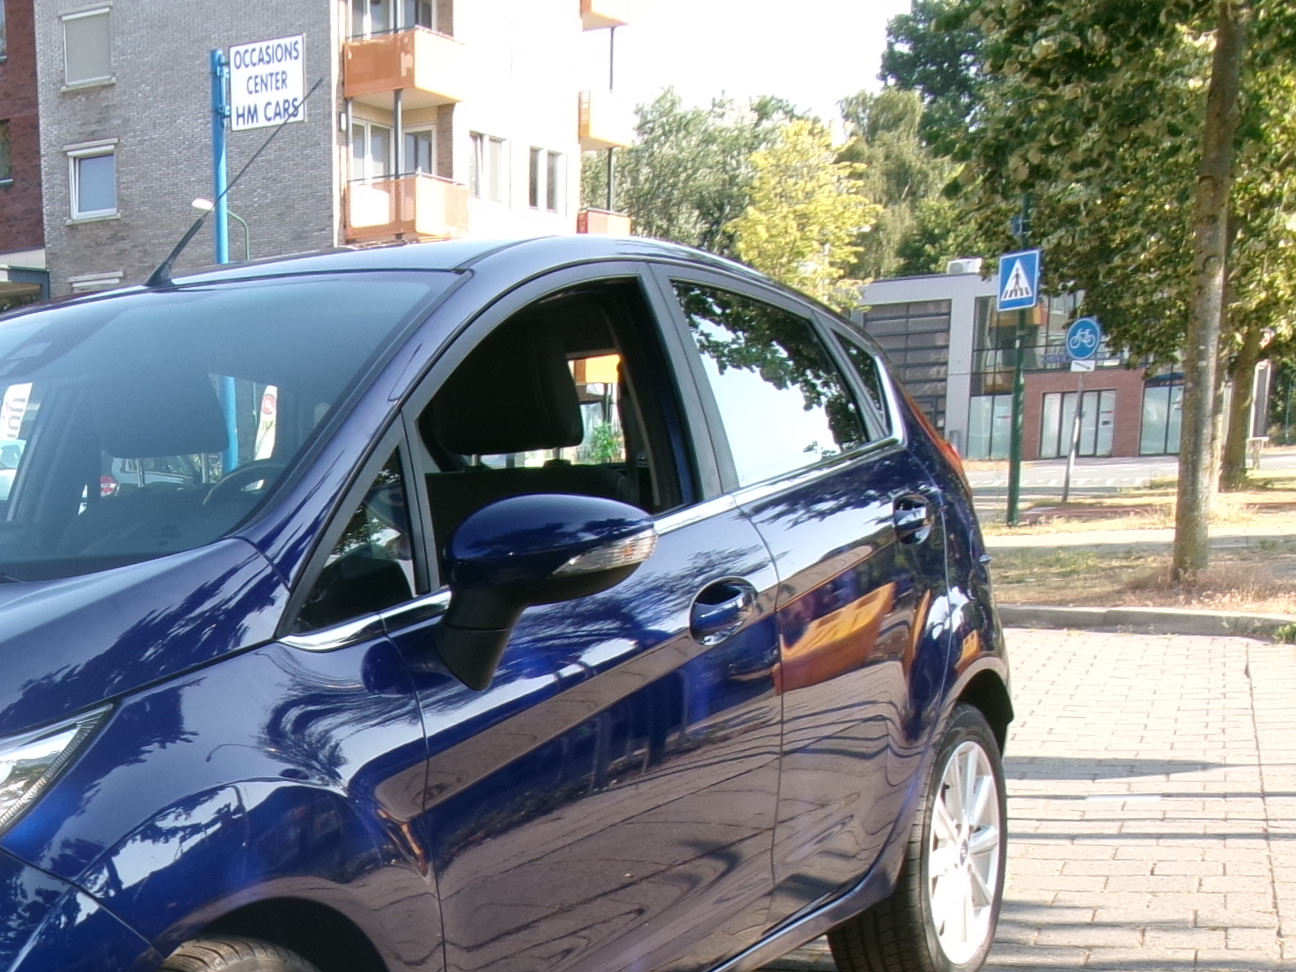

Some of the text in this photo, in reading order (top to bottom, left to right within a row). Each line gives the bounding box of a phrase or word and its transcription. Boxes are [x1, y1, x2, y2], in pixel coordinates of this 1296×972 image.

[234, 40, 300, 69] OCCASIONS
[246, 71, 288, 95] CENTER
[236, 97, 299, 127] HM CARS
